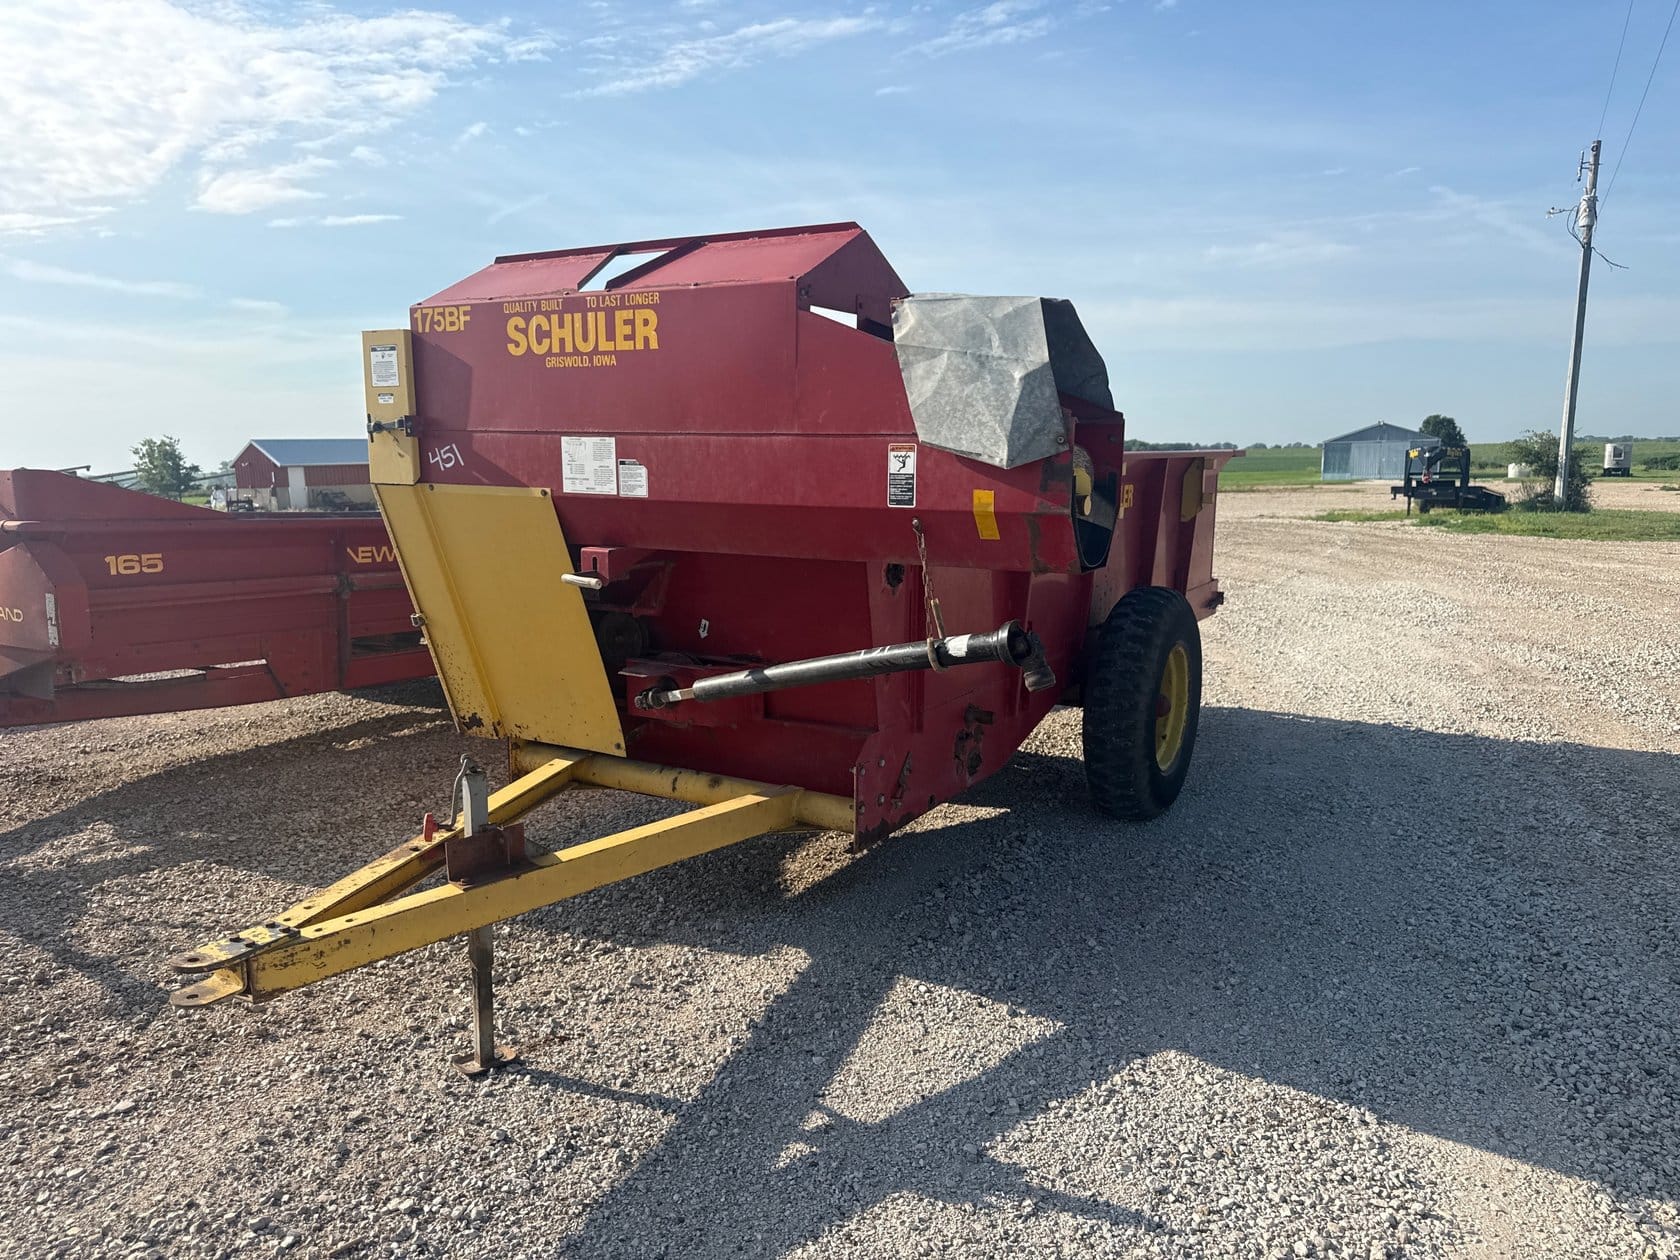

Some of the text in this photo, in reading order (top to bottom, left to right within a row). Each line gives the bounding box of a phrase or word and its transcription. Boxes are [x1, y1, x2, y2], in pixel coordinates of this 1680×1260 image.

[503, 292, 660, 313] QUALITY BUILT TO LAST LONGER
[414, 305, 471, 333] 175BF
[506, 309, 659, 356] SCHULER
[545, 354, 617, 368] GRISWOLD, IOWA
[428, 443, 465, 471] 451
[104, 553, 164, 576] 165
